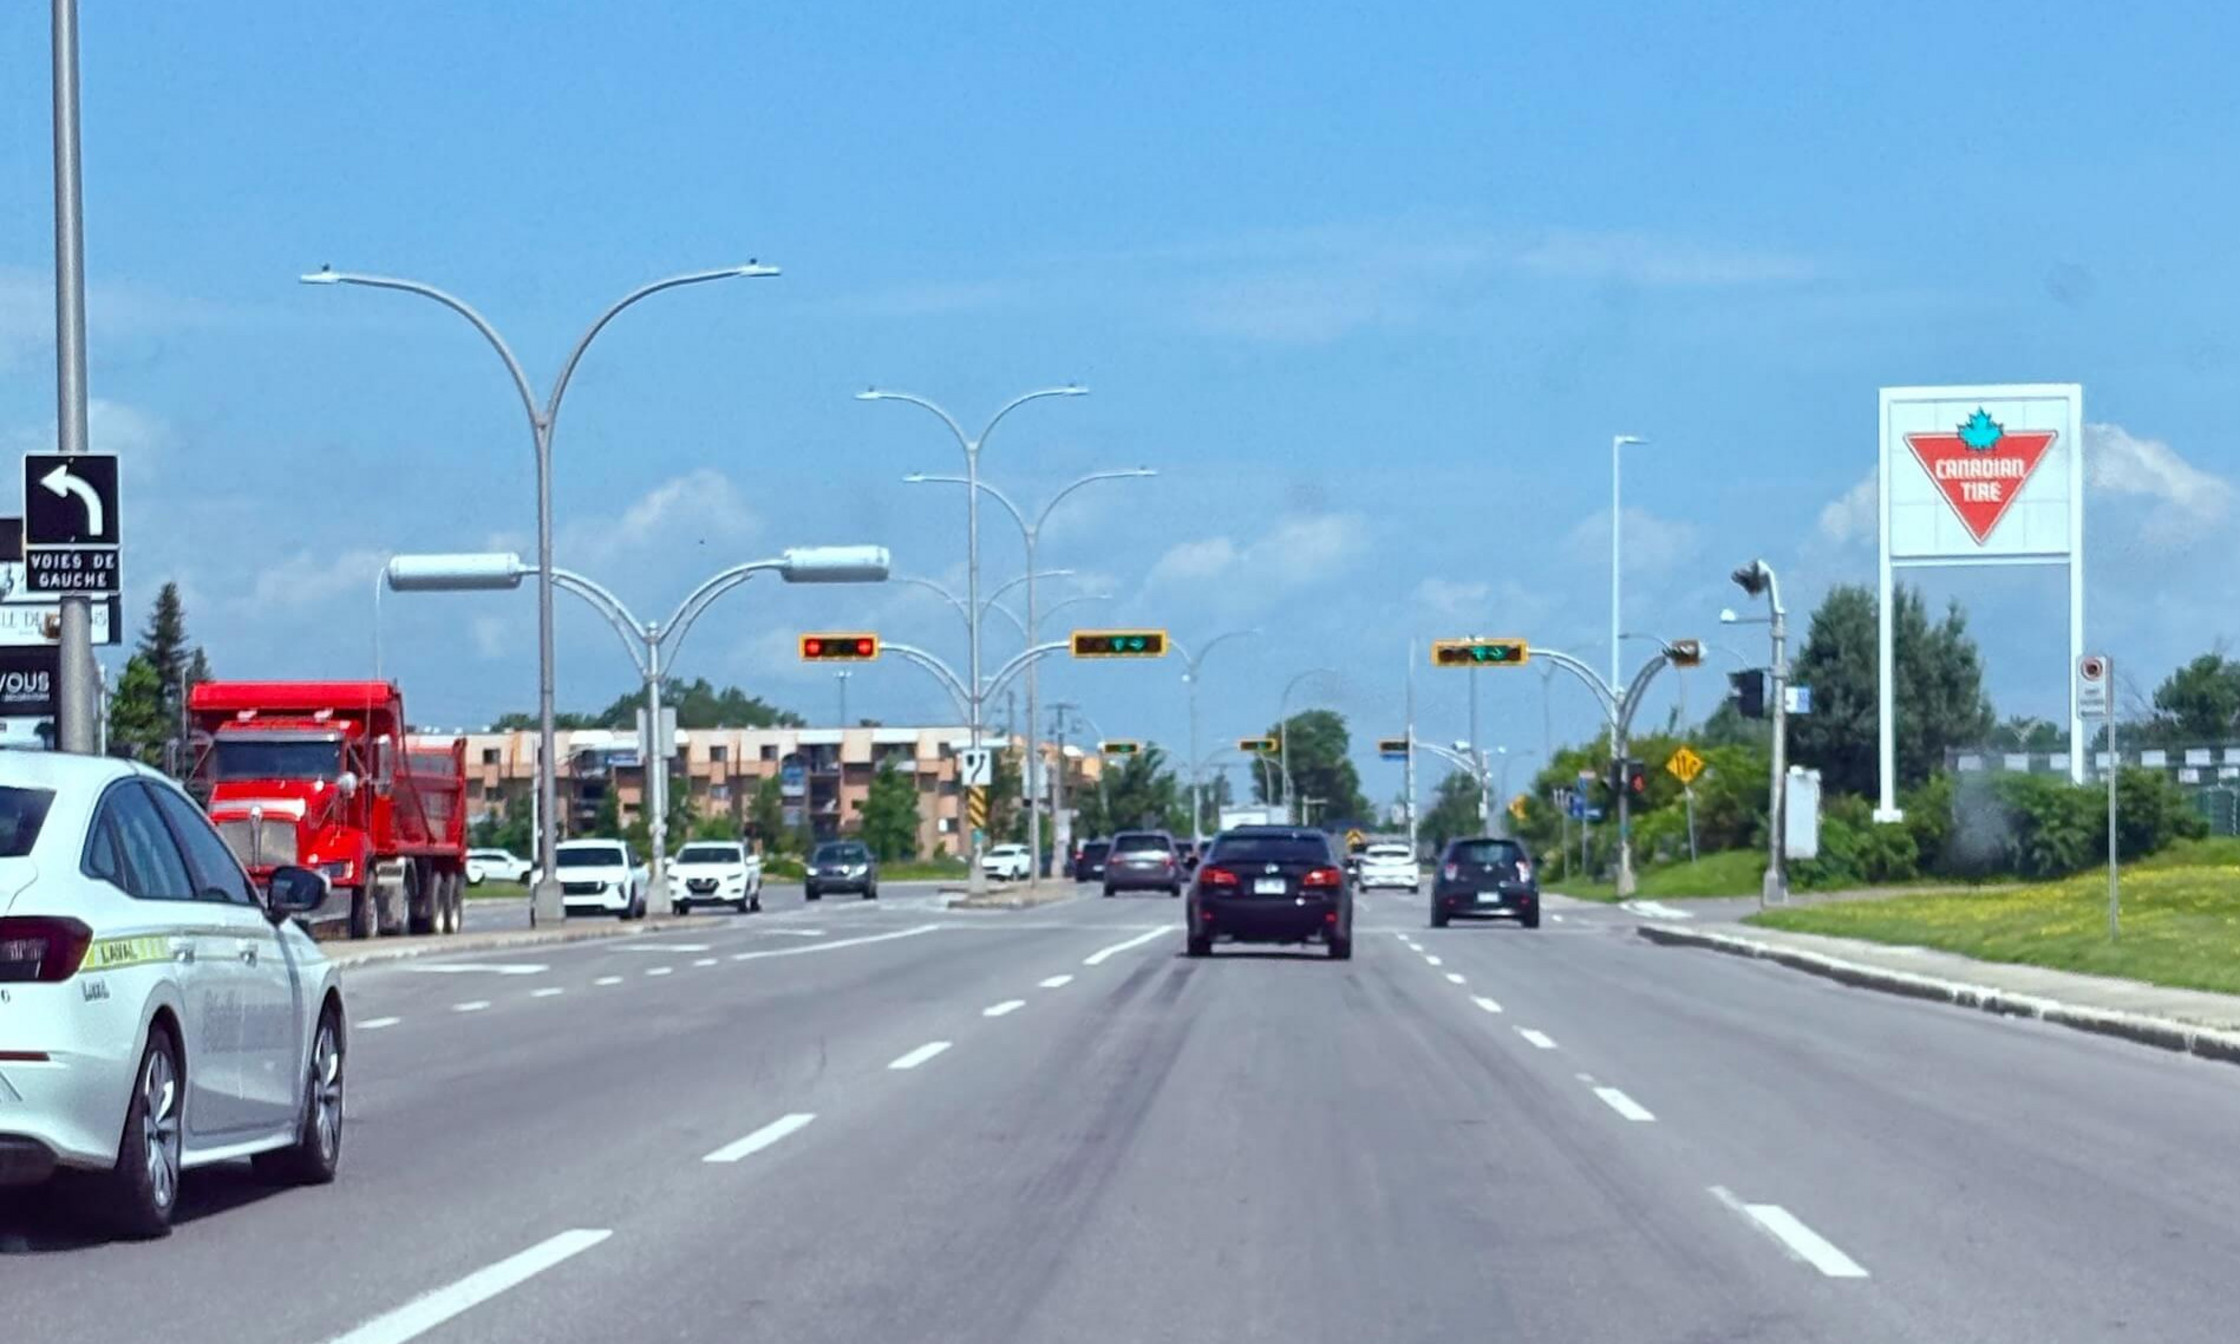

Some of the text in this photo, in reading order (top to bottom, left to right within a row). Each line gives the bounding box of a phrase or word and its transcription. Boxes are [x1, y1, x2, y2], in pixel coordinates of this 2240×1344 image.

[1935, 458, 2025, 480] CANADIAN
[1960, 480, 2003, 502] TIRE
[31, 553, 116, 570] VOIES DE
[39, 571, 107, 589] GAUCHE
